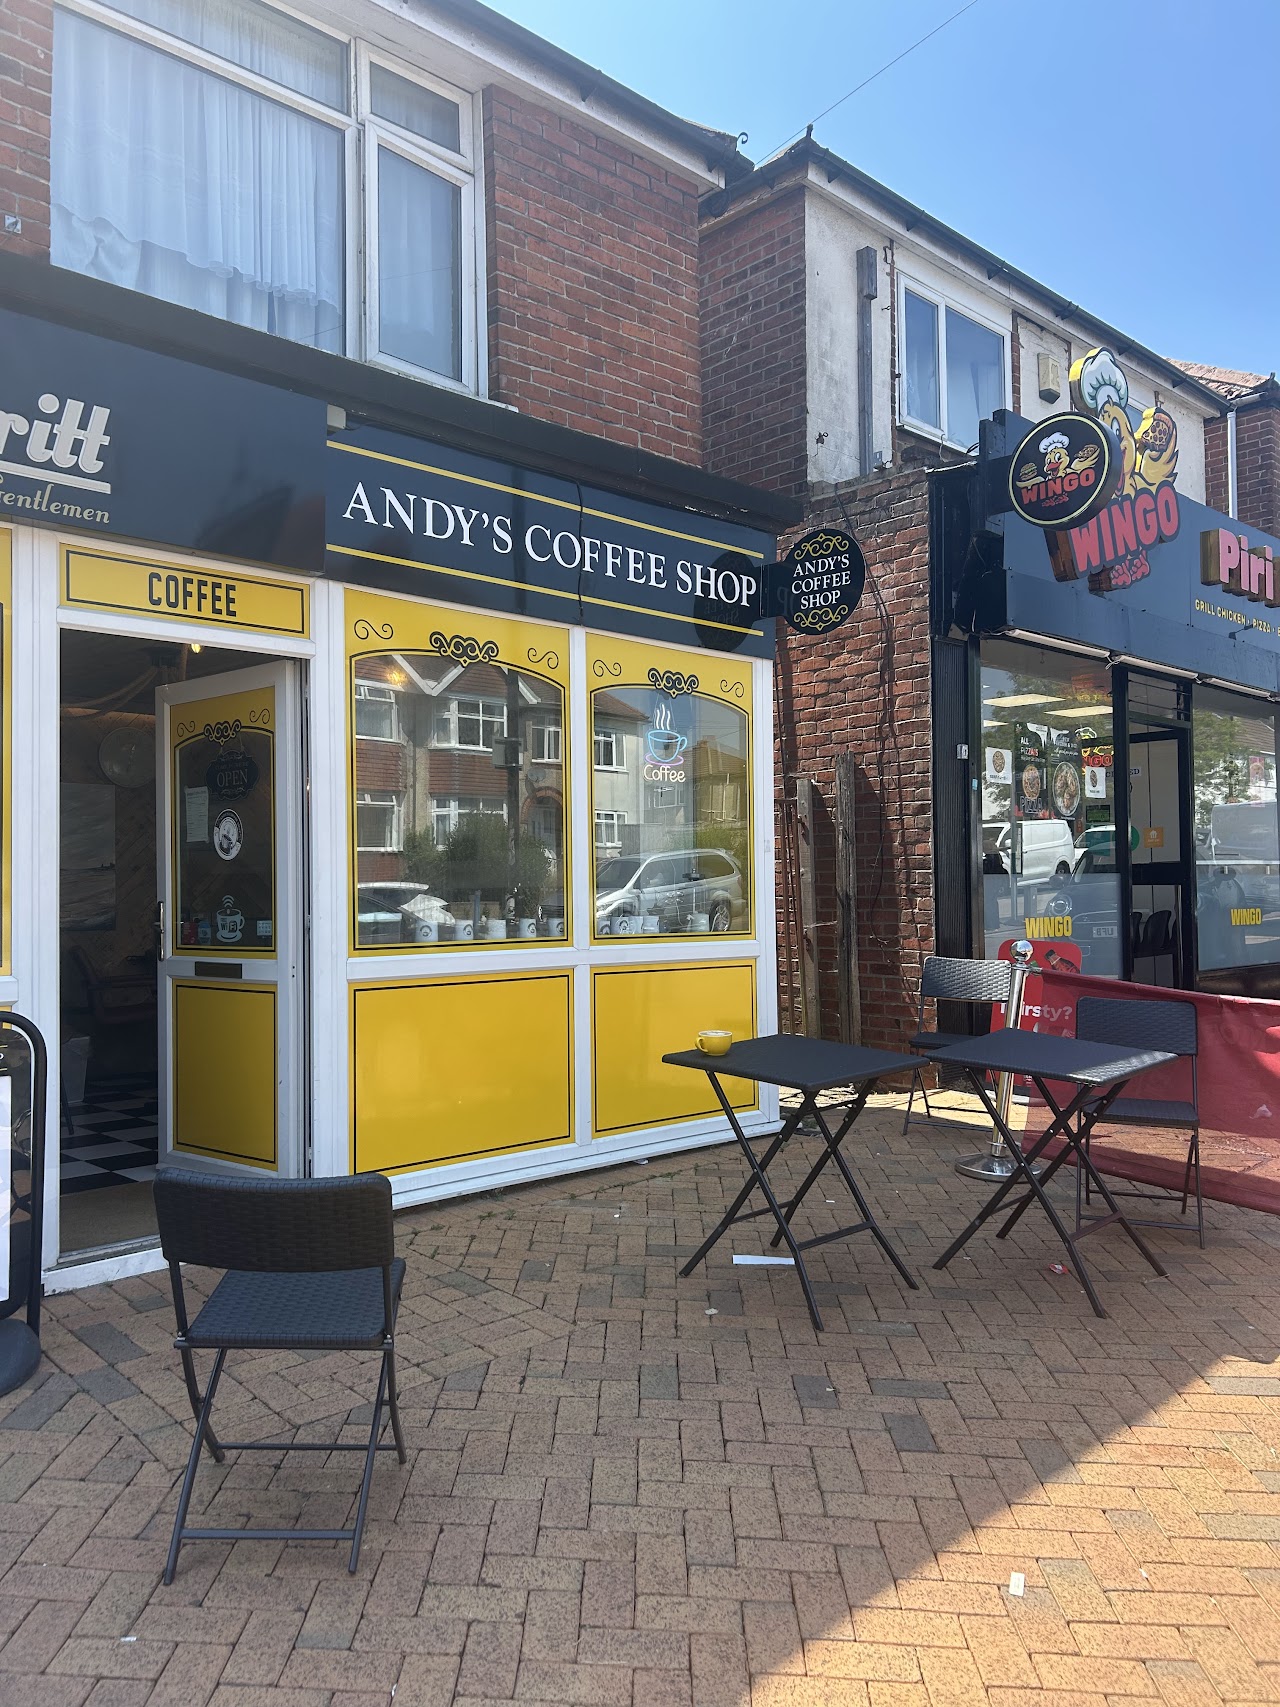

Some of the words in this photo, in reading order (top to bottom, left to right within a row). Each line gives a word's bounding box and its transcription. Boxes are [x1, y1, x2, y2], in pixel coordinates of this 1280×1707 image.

[1020, 467, 1096, 505] WINGO
[1070, 485, 1180, 573] WINGO
[342, 481, 514, 555] ANDY'S
[524, 523, 668, 590] COFFEE
[675, 559, 757, 608] SHOP
[792, 553, 850, 578] ANDY'S
[1218, 527, 1274, 601] Piri
[148, 571, 237, 618] COFFEE
[791, 570, 852, 595] COFFEE
[800, 589, 841, 610] SHOP
[1195, 599, 1216, 616] GRILL
[1217, 606, 1246, 625] CHICKEN
[1252, 618, 1271, 634] PIZZA
[216, 769, 248, 787] OPEN
[643, 764, 686, 783] Coffee
[1025, 915, 1073, 939] WINGO
[1231, 907, 1262, 926] WINGO
[1000, 1002, 1073, 1022] Tirsty?
